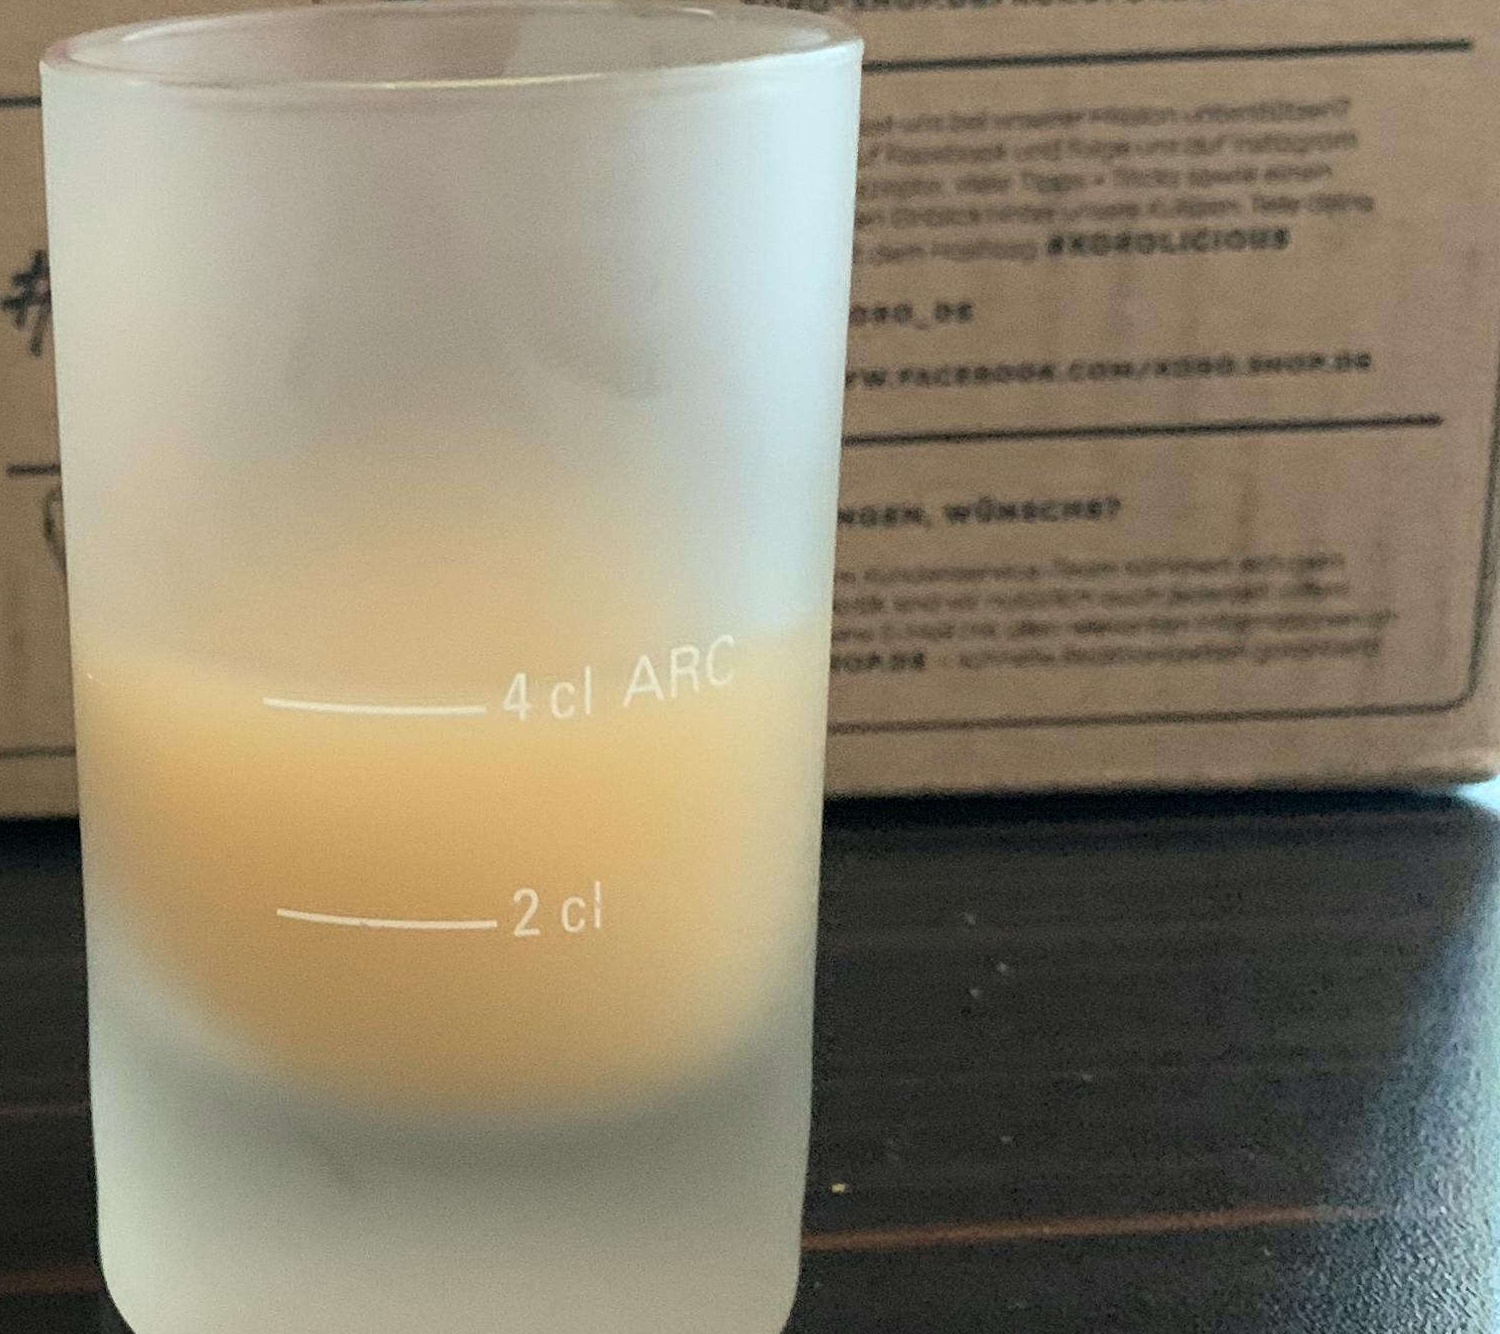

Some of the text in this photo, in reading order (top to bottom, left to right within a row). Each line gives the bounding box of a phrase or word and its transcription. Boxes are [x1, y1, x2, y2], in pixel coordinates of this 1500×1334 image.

[503, 634, 736, 721] 4 cl ARC
[512, 879, 603, 938] 2 cl
